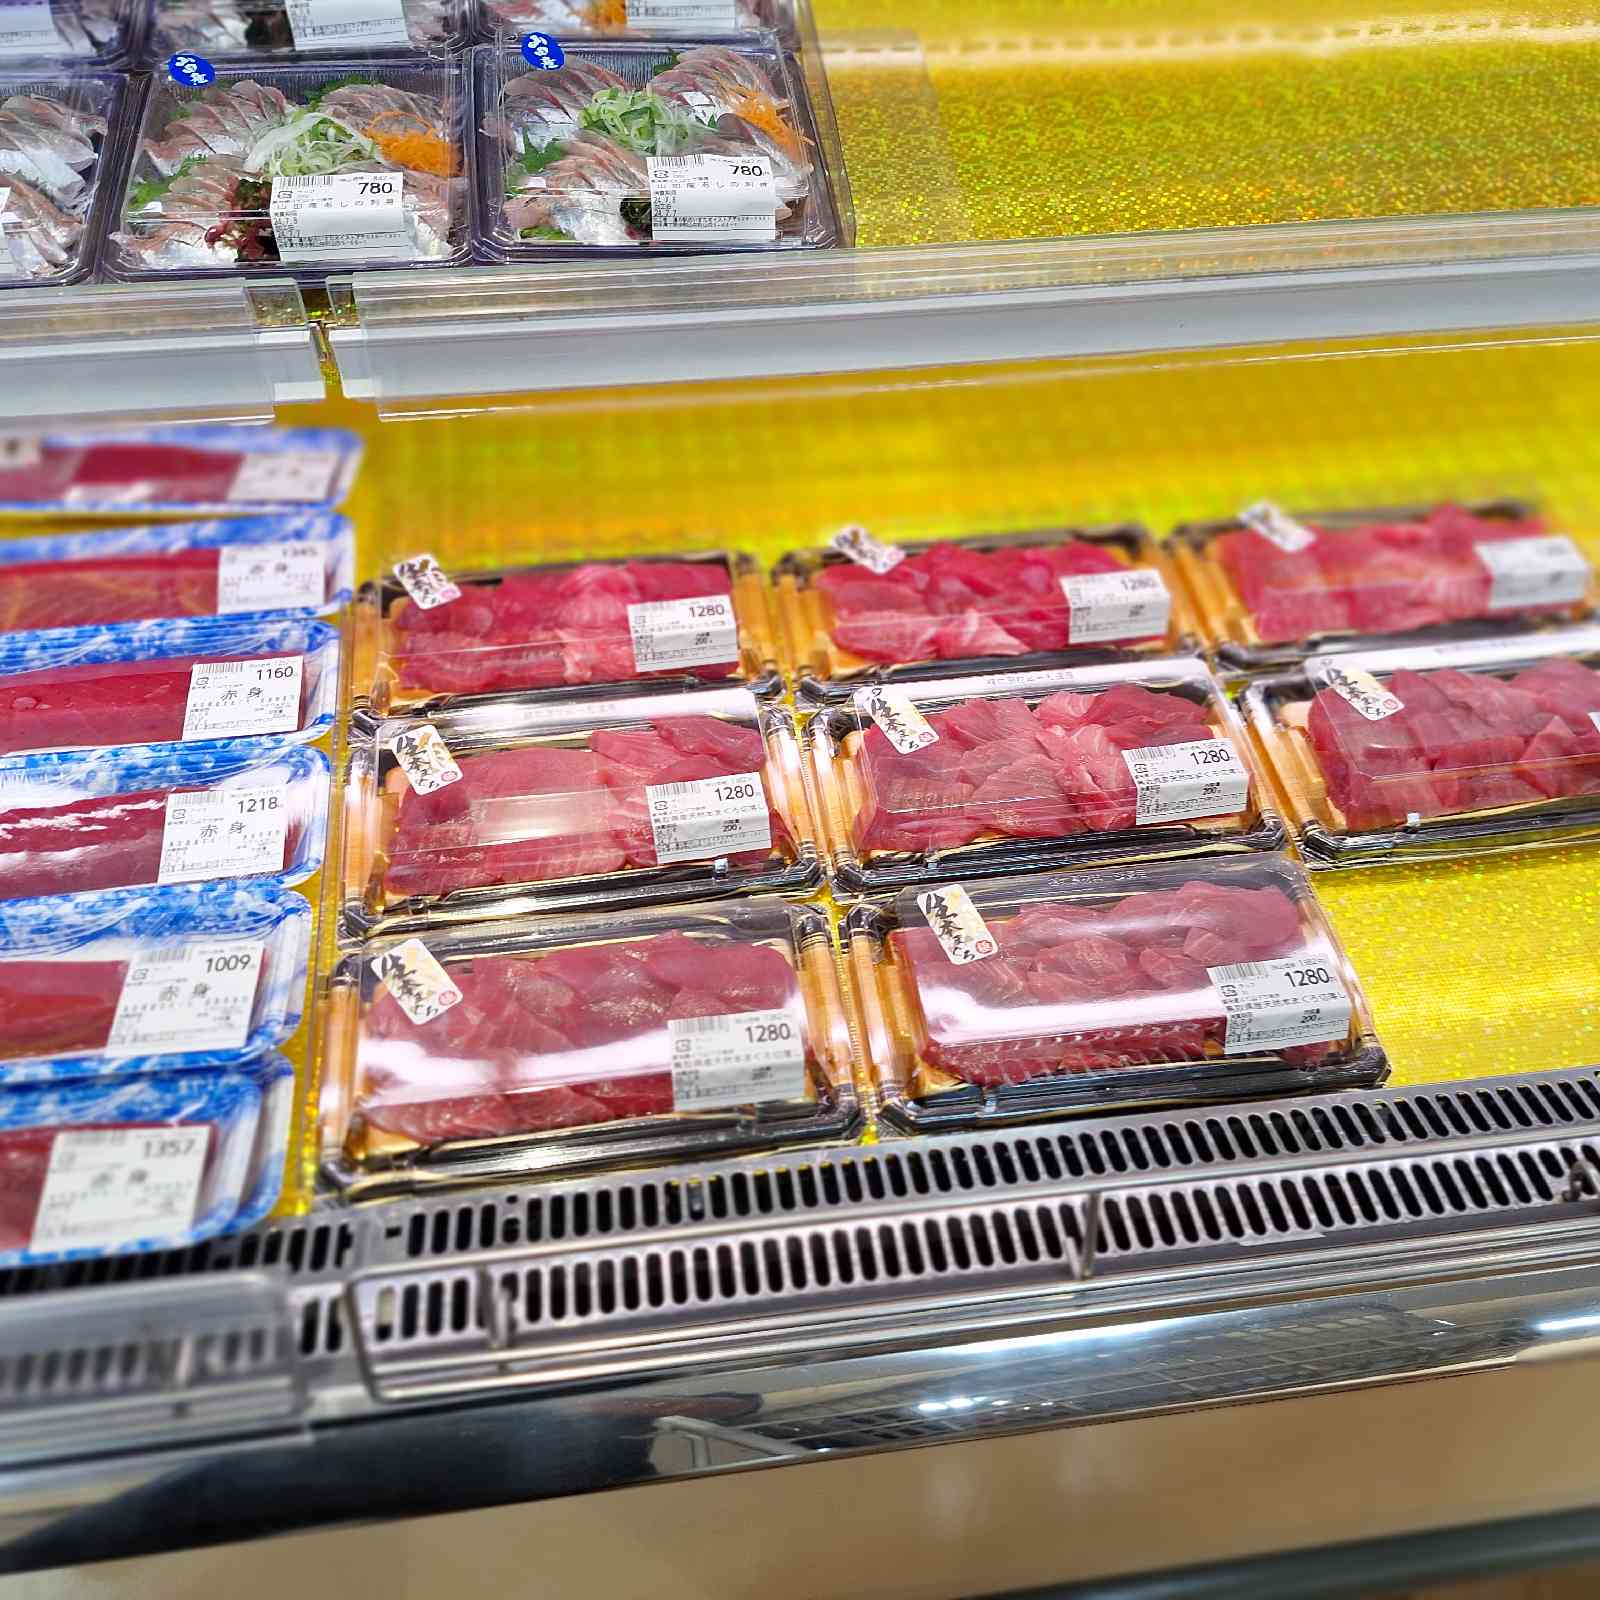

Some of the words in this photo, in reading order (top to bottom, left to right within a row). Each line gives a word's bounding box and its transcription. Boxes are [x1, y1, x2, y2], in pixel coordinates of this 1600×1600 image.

[729, 164, 763, 177] 780
[359, 182, 393, 195] 780
[689, 604, 725, 618] 1280
[256, 665, 294, 681] 1160
[220, 686, 264, 701] 赤身
[1190, 748, 1231, 766] 1280
[714, 783, 755, 802] 1280
[238, 796, 278, 814] 1218
[200, 820, 247, 839] 赤身
[925, 892, 976, 961] 生本まぐろ
[206, 954, 251, 974] 1009
[1284, 967, 1330, 988] 1280
[745, 1022, 791, 1043] 1280
[144, 1137, 196, 1159] 1357
